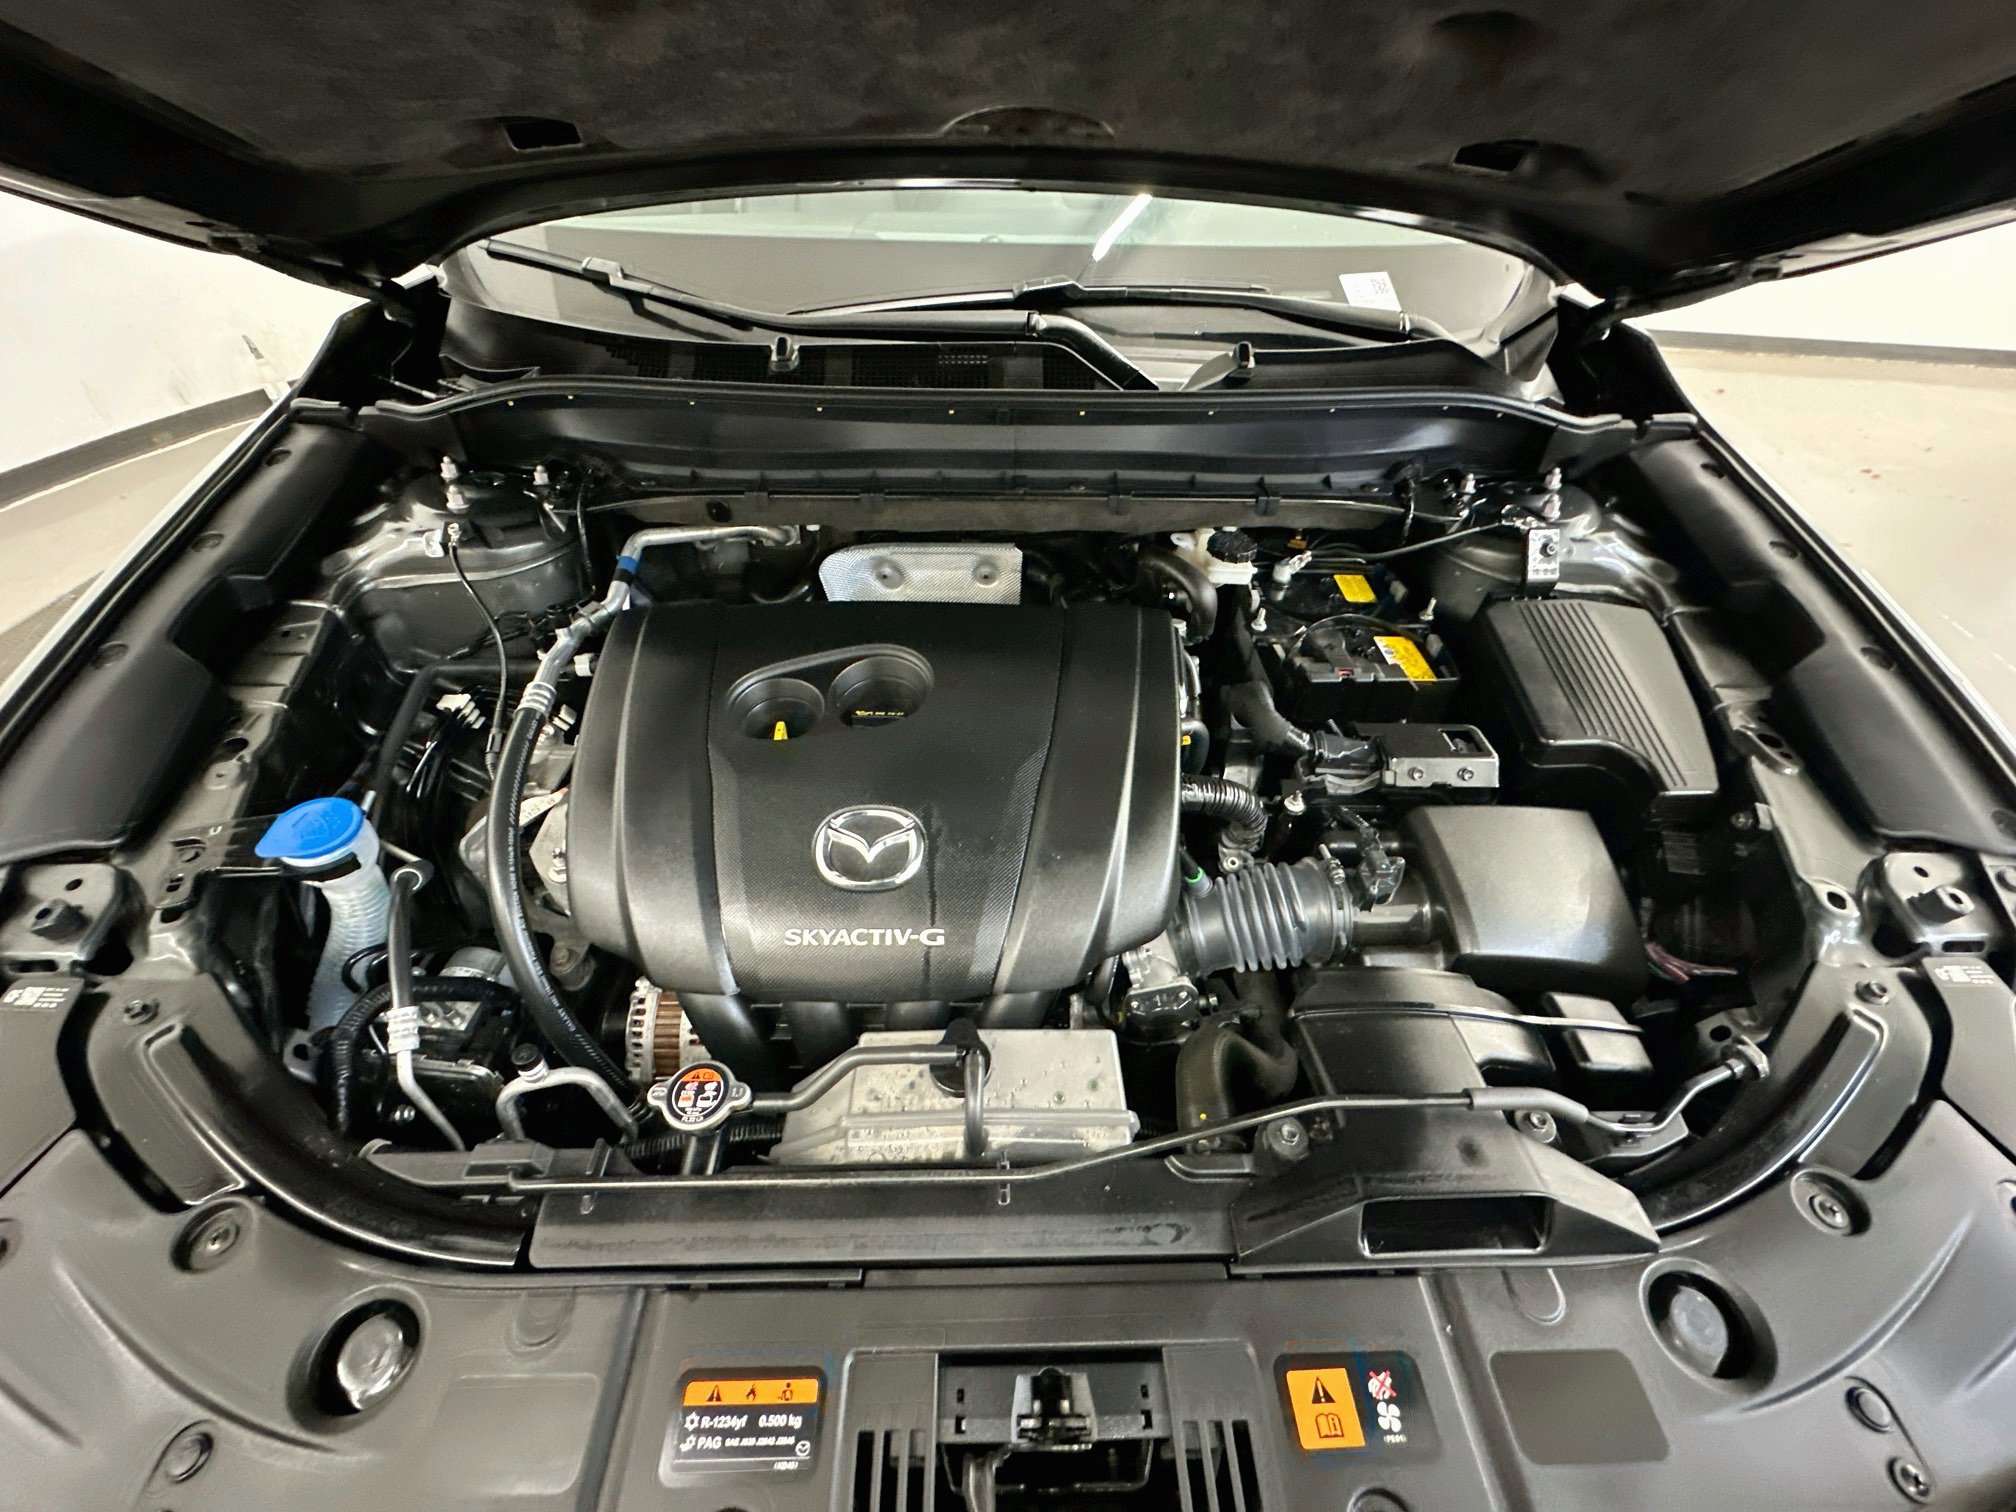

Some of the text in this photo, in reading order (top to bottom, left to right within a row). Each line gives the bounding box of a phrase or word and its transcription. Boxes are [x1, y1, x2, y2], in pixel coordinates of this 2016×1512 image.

[784, 928, 945, 946] SKYACTIV-G
[700, 1414, 802, 1430] R-1234yf 0.500 kg
[696, 1436, 722, 1450] PAG
